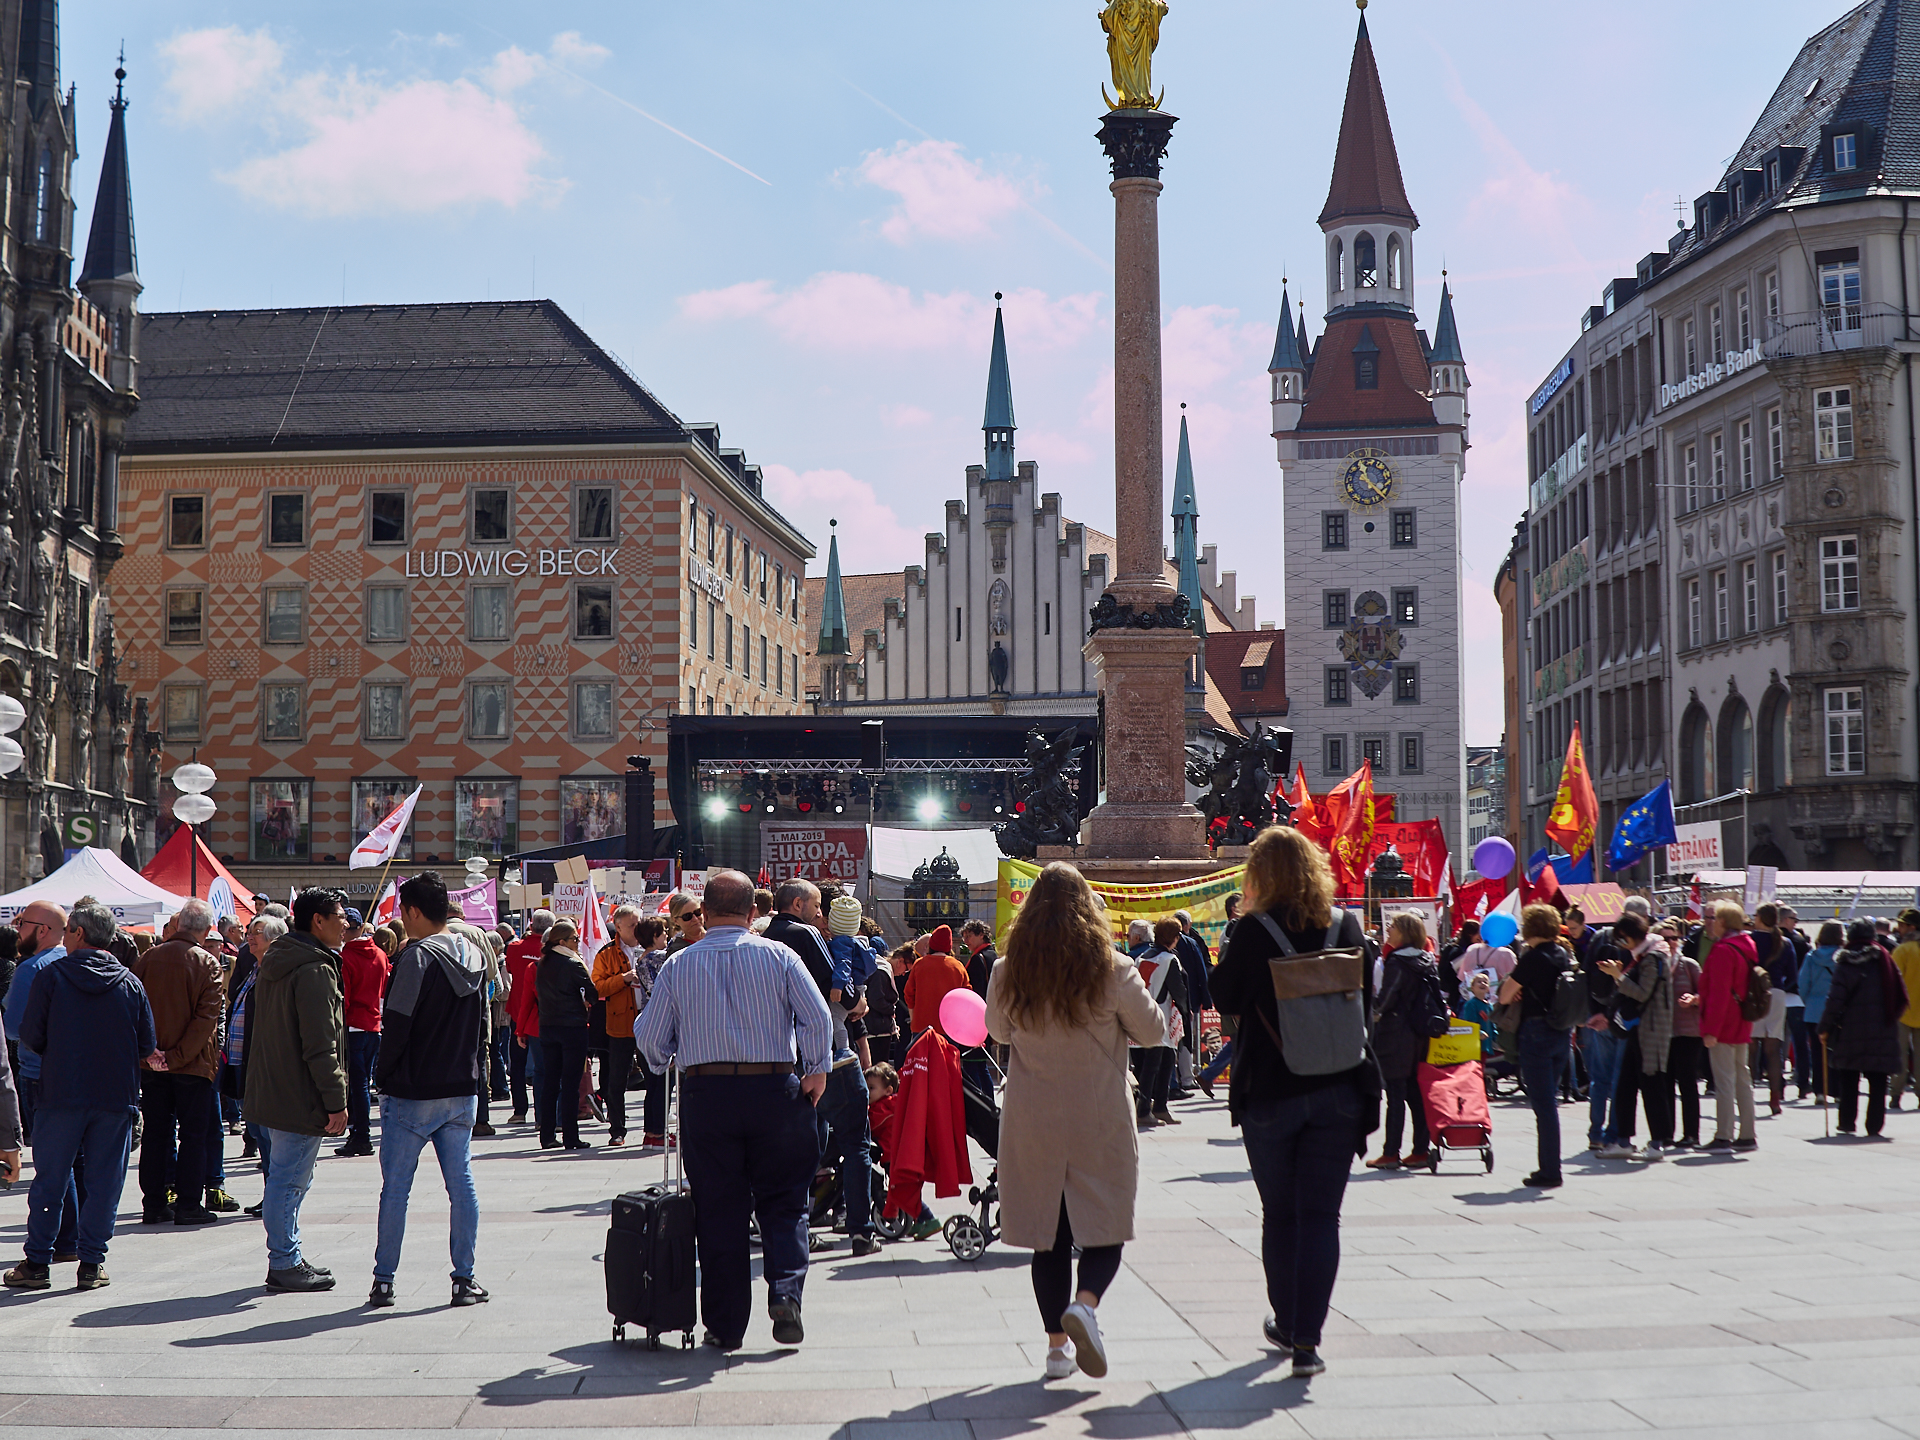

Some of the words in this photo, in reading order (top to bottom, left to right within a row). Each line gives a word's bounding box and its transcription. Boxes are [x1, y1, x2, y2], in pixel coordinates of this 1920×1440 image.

[1662, 363, 1722, 408] Deutsche
[1726, 339, 1762, 376] Bank
[405, 550, 529, 577] LUDWIG
[539, 549, 619, 576] BECK
[71, 816, 93, 843] S
[771, 834, 779, 842] 1.
[781, 833, 799, 842] MAI
[802, 832, 822, 841] 2019
[769, 842, 855, 862] EUROPA.
[1669, 835, 1718, 862] GETRÄNKE
[769, 861, 822, 880] JETZT
[347, 883, 390, 894] LUDWG
[1092, 871, 1237, 893] BEITEREINHEIT
[0, 906, 24, 918] EV
